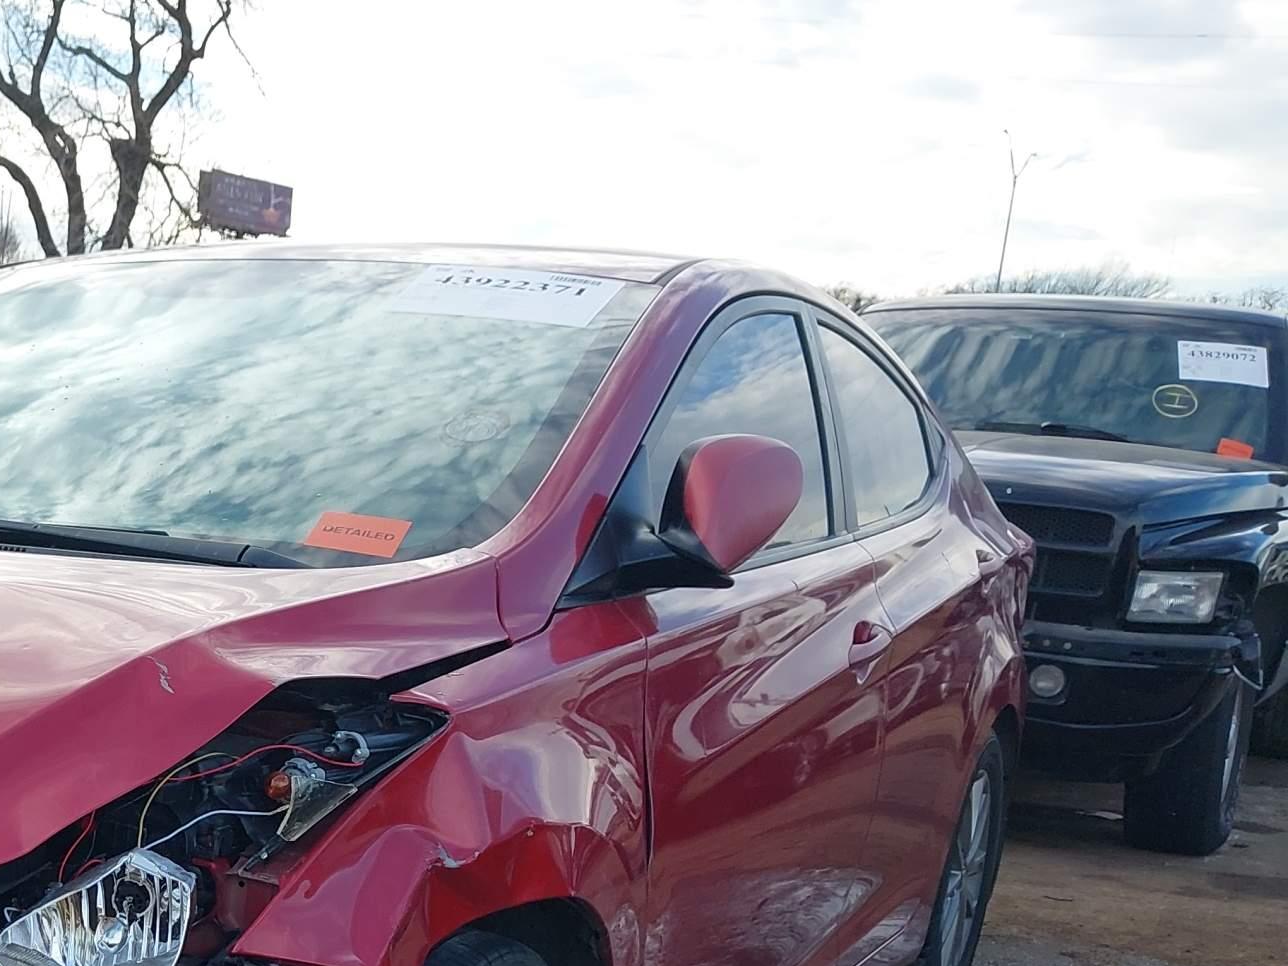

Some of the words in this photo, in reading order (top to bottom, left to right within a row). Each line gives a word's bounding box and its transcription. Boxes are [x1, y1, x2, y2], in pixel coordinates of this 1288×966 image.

[434, 273, 587, 297] 43922371
[1187, 349, 1257, 362] 43829072
[322, 525, 396, 541] DETAILED
